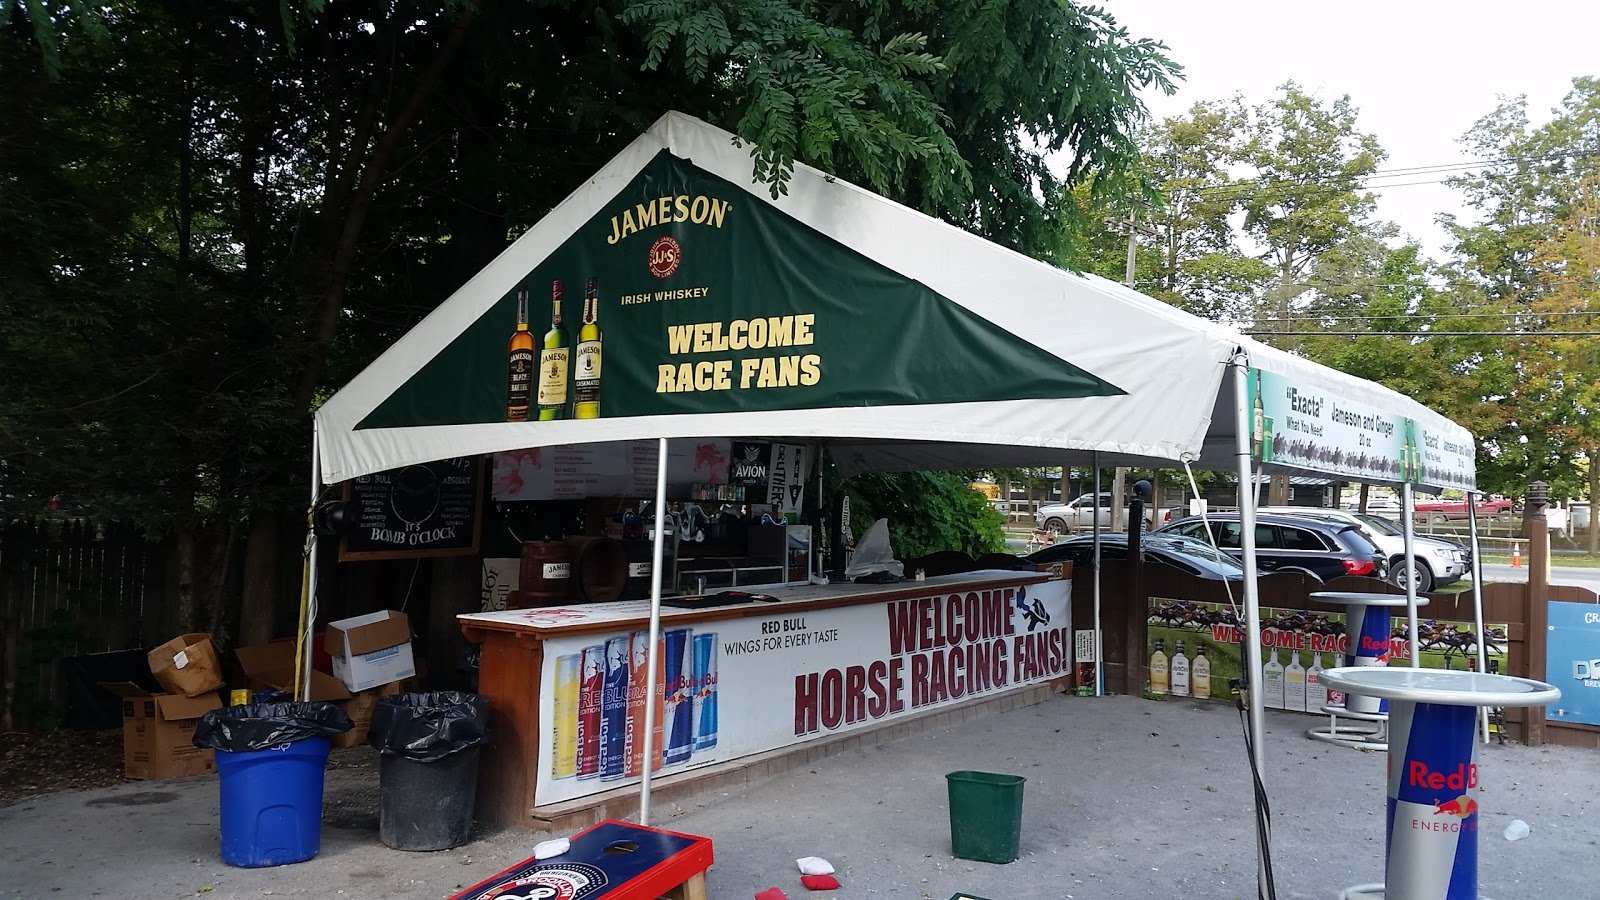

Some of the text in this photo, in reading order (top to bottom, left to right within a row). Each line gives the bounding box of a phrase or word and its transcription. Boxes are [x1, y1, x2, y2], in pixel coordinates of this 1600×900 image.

[607, 195, 729, 245] JAMESON
[621, 287, 709, 306] IRISH WHISKEY
[667, 313, 816, 355] WELCOME
[510, 353, 533, 363] JAMESON
[542, 353, 568, 365] JAMESON
[577, 346, 600, 357] JAMESON
[656, 354, 822, 394] RACE FANS
[1286, 415, 1300, 431] What
[1300, 419, 1309, 434] You
[1331, 401, 1362, 428] Jameson
[1363, 413, 1375, 431] and
[1375, 414, 1394, 439] Ginger
[1359, 433, 1366, 446] 20
[374, 474, 392, 484] BULL
[370, 527, 406, 544] BOMB
[761, 617, 807, 634] RED BULL
[887, 588, 1017, 657] WELCOME
[724, 629, 839, 656] WINGS FOR EVERY TASTE
[1310, 631, 1349, 654] RAC
[1362, 636, 1389, 650] Red
[794, 655, 905, 737] HORSE
[911, 638, 1009, 709] RACING
[1013, 626, 1069, 683] FANS!
[580, 690, 600, 709] RE
[605, 686, 628, 704] BLU
[580, 706, 600, 715] EDITION
[605, 701, 626, 710] EDITION
[576, 720, 585, 774] Red Bull
[600, 717, 609, 775] Red Bull
[625, 716, 634, 774] Red Bull
[1409, 761, 1465, 791] Red
[1412, 819, 1467, 833] ENERGY
[515, 876, 574, 898] BROOKLYN
